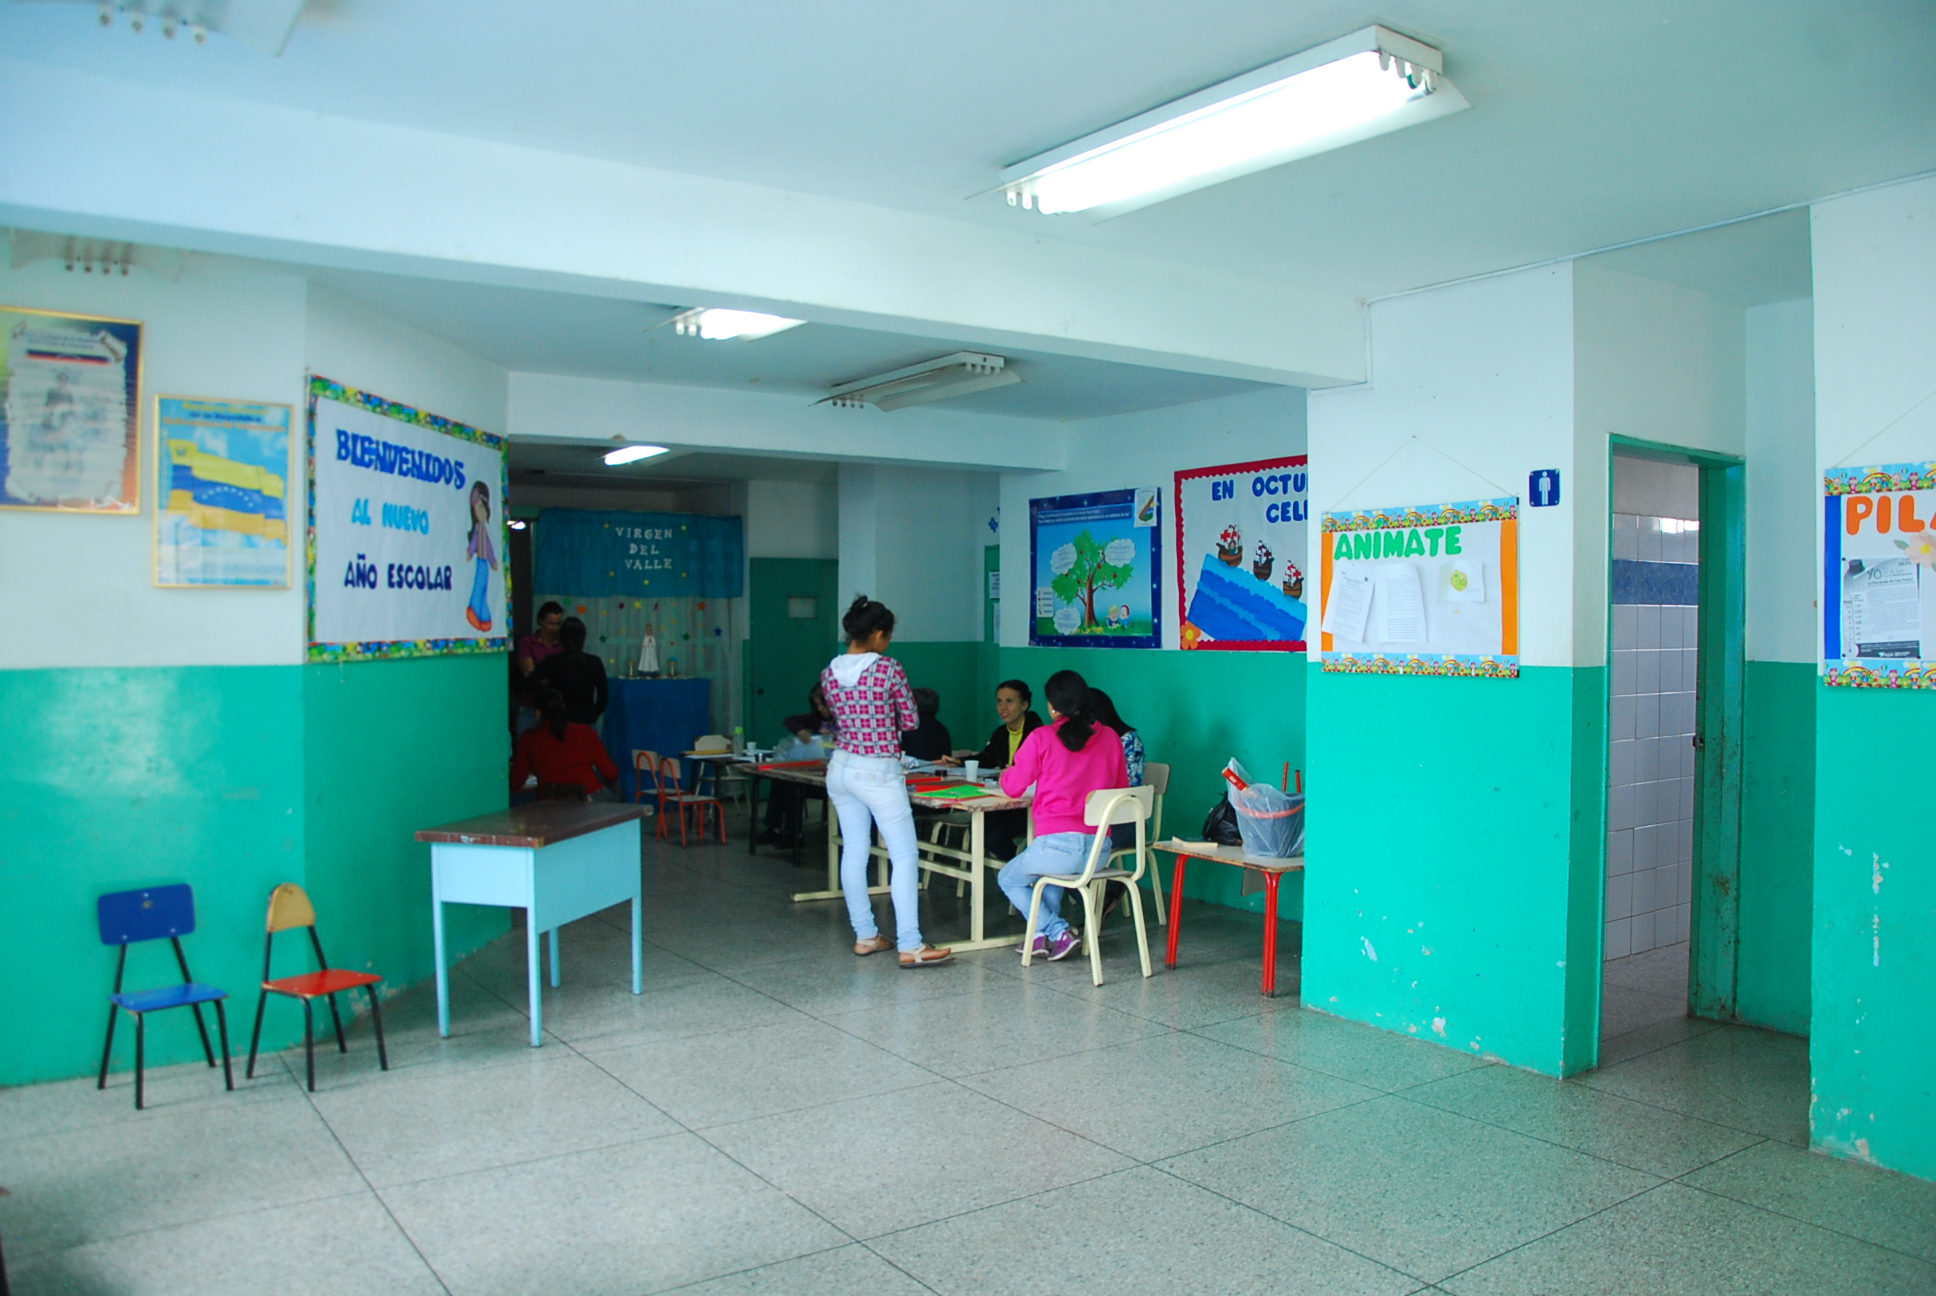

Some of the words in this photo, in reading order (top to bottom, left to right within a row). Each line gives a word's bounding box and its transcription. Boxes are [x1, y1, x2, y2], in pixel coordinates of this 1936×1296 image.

[335, 428, 466, 490] BIENVENIDOS
[1211, 479, 1235, 501] EN
[1251, 472, 1308, 498] OCTU
[352, 497, 371, 526] AL
[381, 502, 430, 535] NUEVO
[1845, 494, 1936, 536] PIL
[615, 527, 672, 540] VIRGEN
[629, 543, 659, 556] DEL
[344, 553, 378, 590] AÑO
[387, 562, 453, 592] ESCOLAR
[624, 558, 673, 570] VALLE
